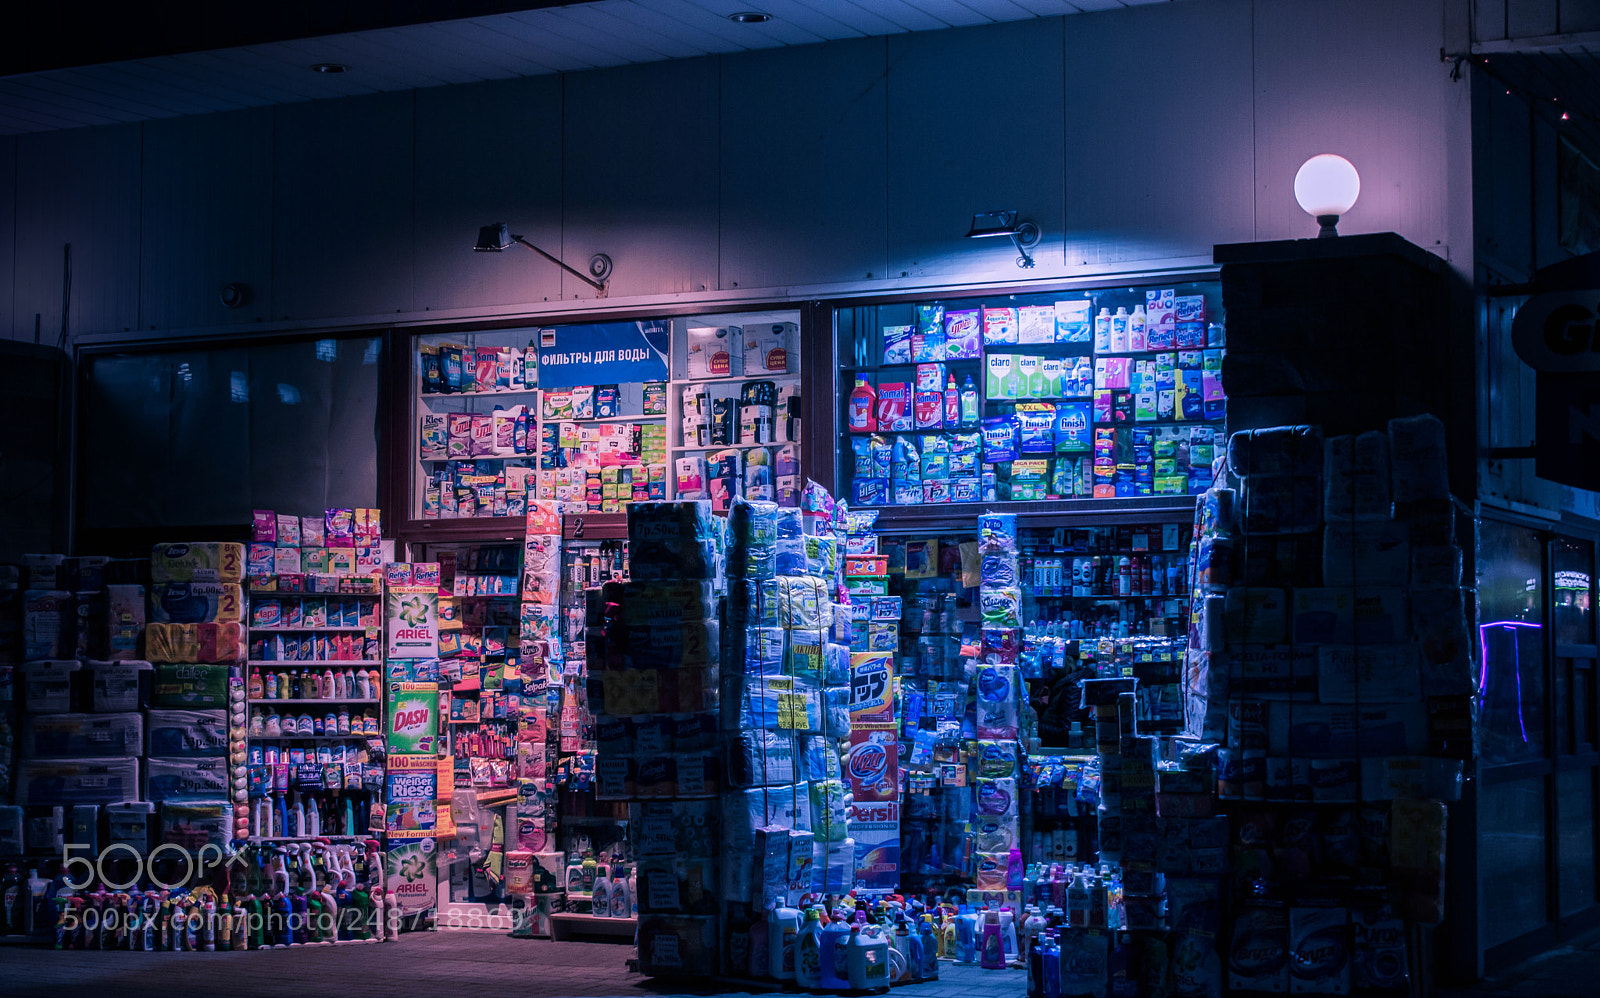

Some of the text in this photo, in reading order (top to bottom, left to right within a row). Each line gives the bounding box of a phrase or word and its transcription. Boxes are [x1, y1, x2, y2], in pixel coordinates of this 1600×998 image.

[1148, 299, 1173, 310] DUO
[541, 347, 650, 366] ФИЛЬТРЫ ДЛЯ ВОДЫ
[990, 357, 1010, 367] claro
[1020, 359, 1036, 367] claro
[1043, 363, 1059, 371] claro
[879, 389, 904, 400] Somat
[916, 393, 939, 403] Somat
[1061, 417, 1085, 428] finish
[573, 517, 584, 538] 2
[223, 554, 236, 571] 2
[358, 557, 381, 565] DUO
[388, 571, 411, 579] Reflect
[416, 571, 439, 580] Reflect
[223, 595, 235, 612] 2
[395, 629, 433, 639] ARIEL
[687, 636, 700, 655] 2
[393, 708, 429, 732] DASH
[389, 756, 409, 768] 100
[394, 777, 433, 786] Weißer
[392, 785, 434, 797] Riese
[406, 830, 437, 838] Formula
[395, 883, 429, 893] ARIEL
